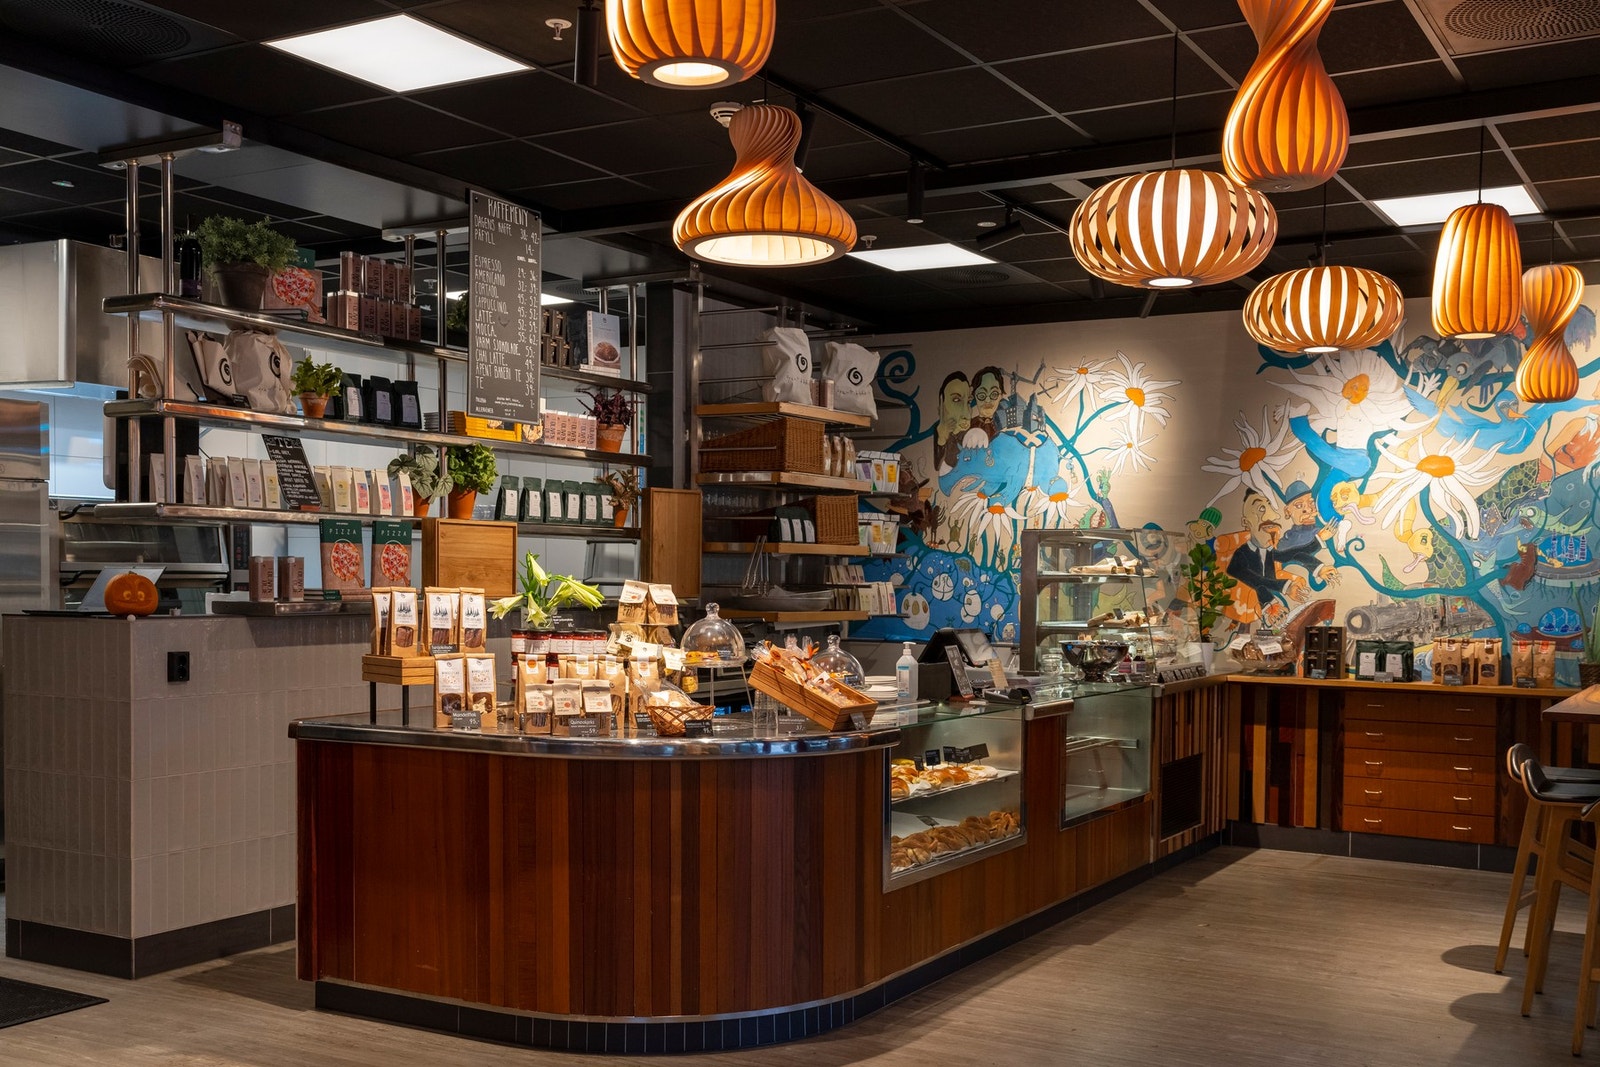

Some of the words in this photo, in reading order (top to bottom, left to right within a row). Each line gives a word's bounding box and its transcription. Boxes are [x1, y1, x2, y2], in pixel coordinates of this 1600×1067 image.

[488, 198, 529, 228] KAFFEMENY
[474, 214, 495, 231] DAGENS
[474, 254, 502, 273] ESPRESSO
[474, 268, 506, 287] AMERICANO
[475, 336, 491, 350] VARM
[475, 349, 488, 363] CHAI
[475, 362, 492, 377] ÅPENT
[493, 366, 512, 380] BAKERI
[514, 368, 522, 382] TE
[475, 376, 485, 389] TE
[274, 437, 293, 449] TE
